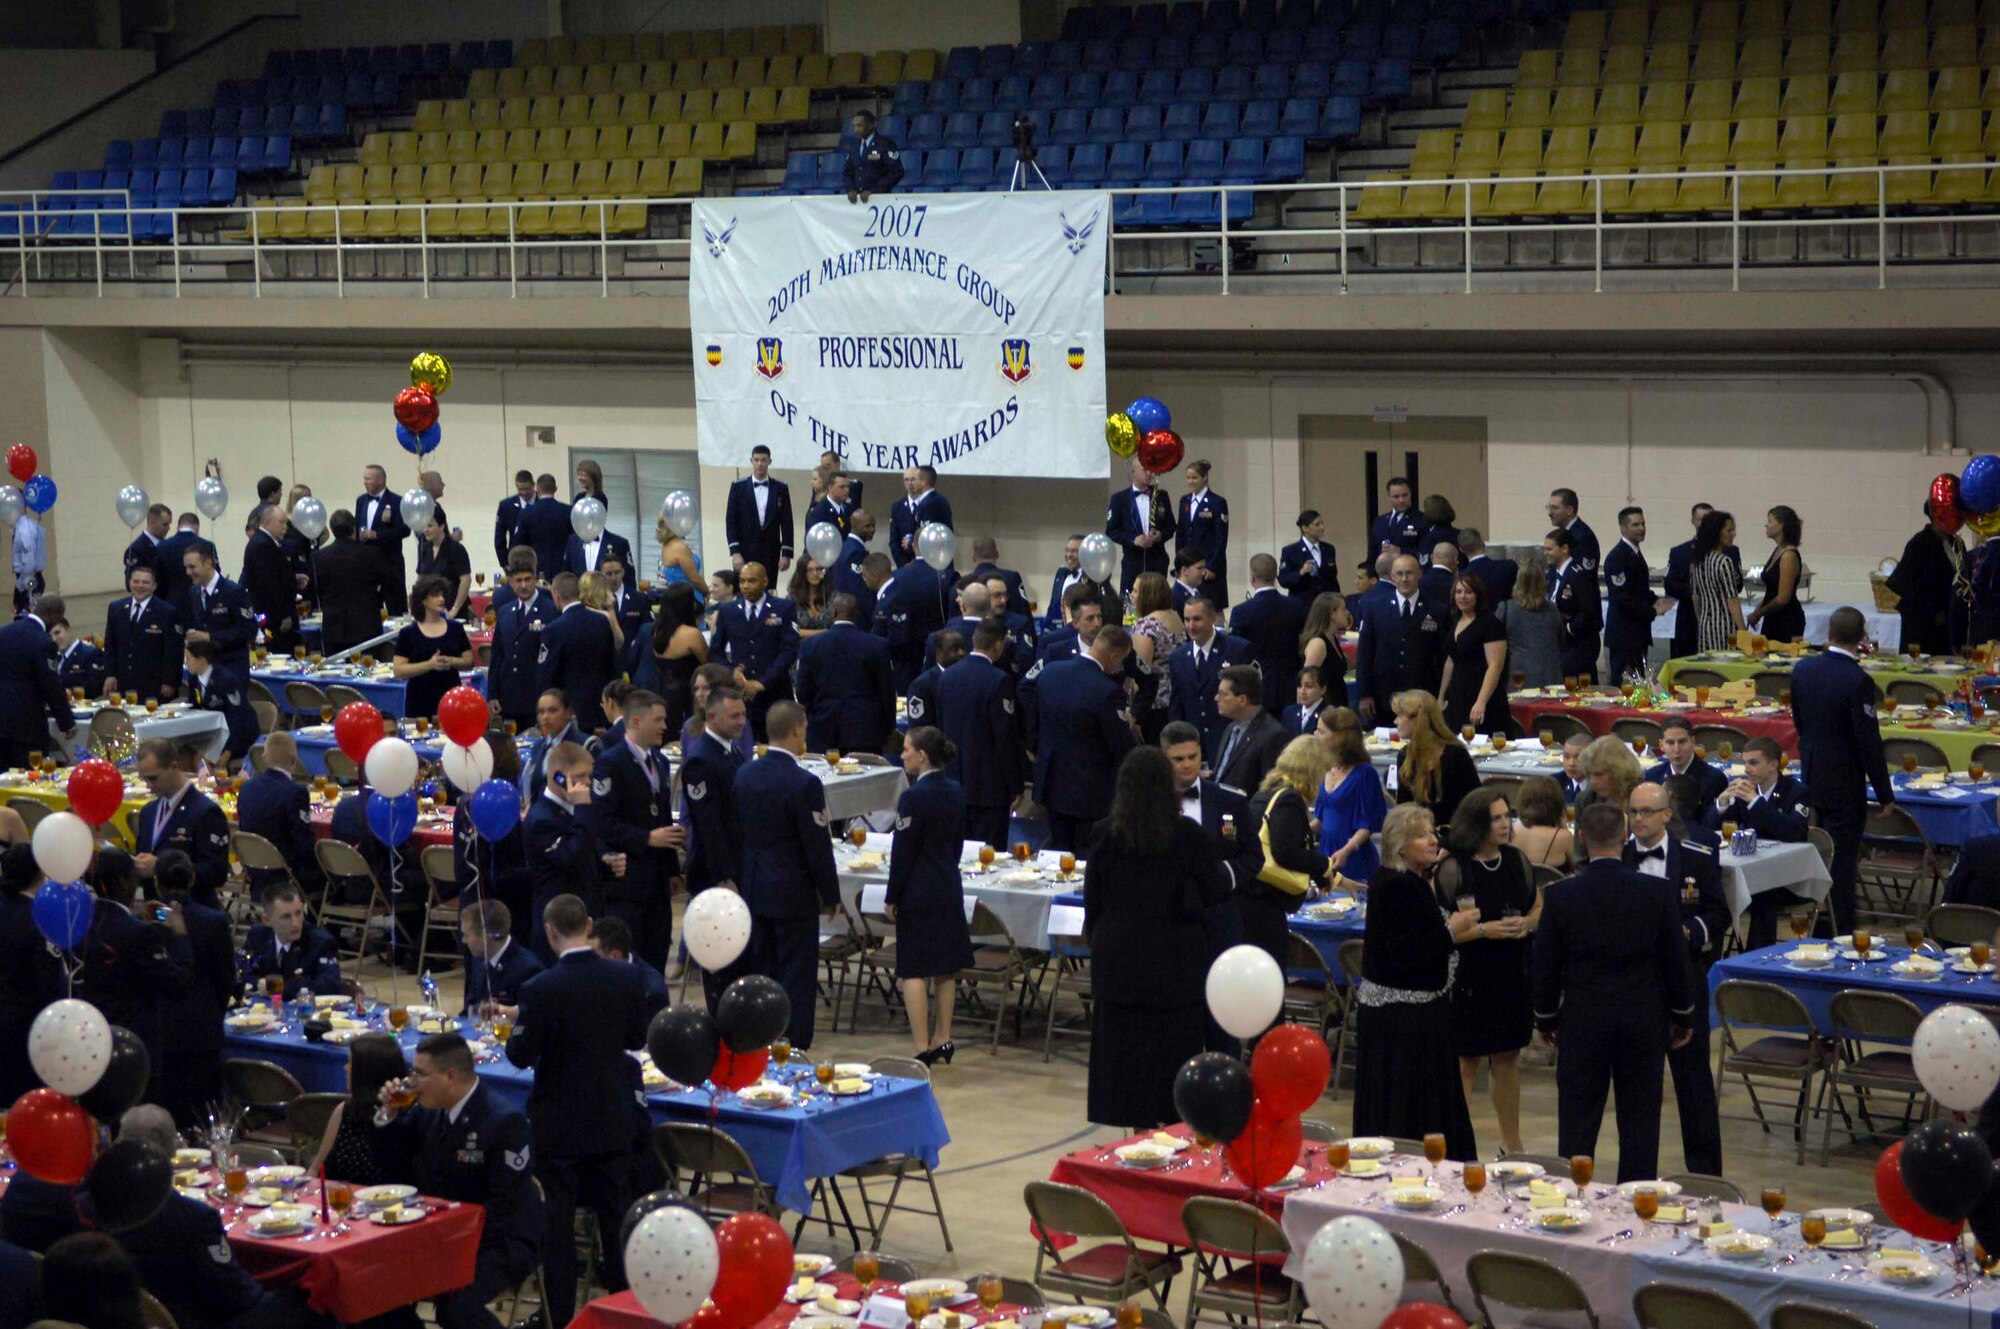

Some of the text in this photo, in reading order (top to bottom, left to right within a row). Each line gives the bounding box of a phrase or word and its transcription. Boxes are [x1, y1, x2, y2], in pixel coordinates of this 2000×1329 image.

[864, 205, 928, 238] 2007
[768, 246, 1016, 326] 20TH MAINTENANCE GROUP
[819, 337, 964, 370] PROFESSIONAL
[770, 390, 1019, 469] OF THE YEAR AWARDS
